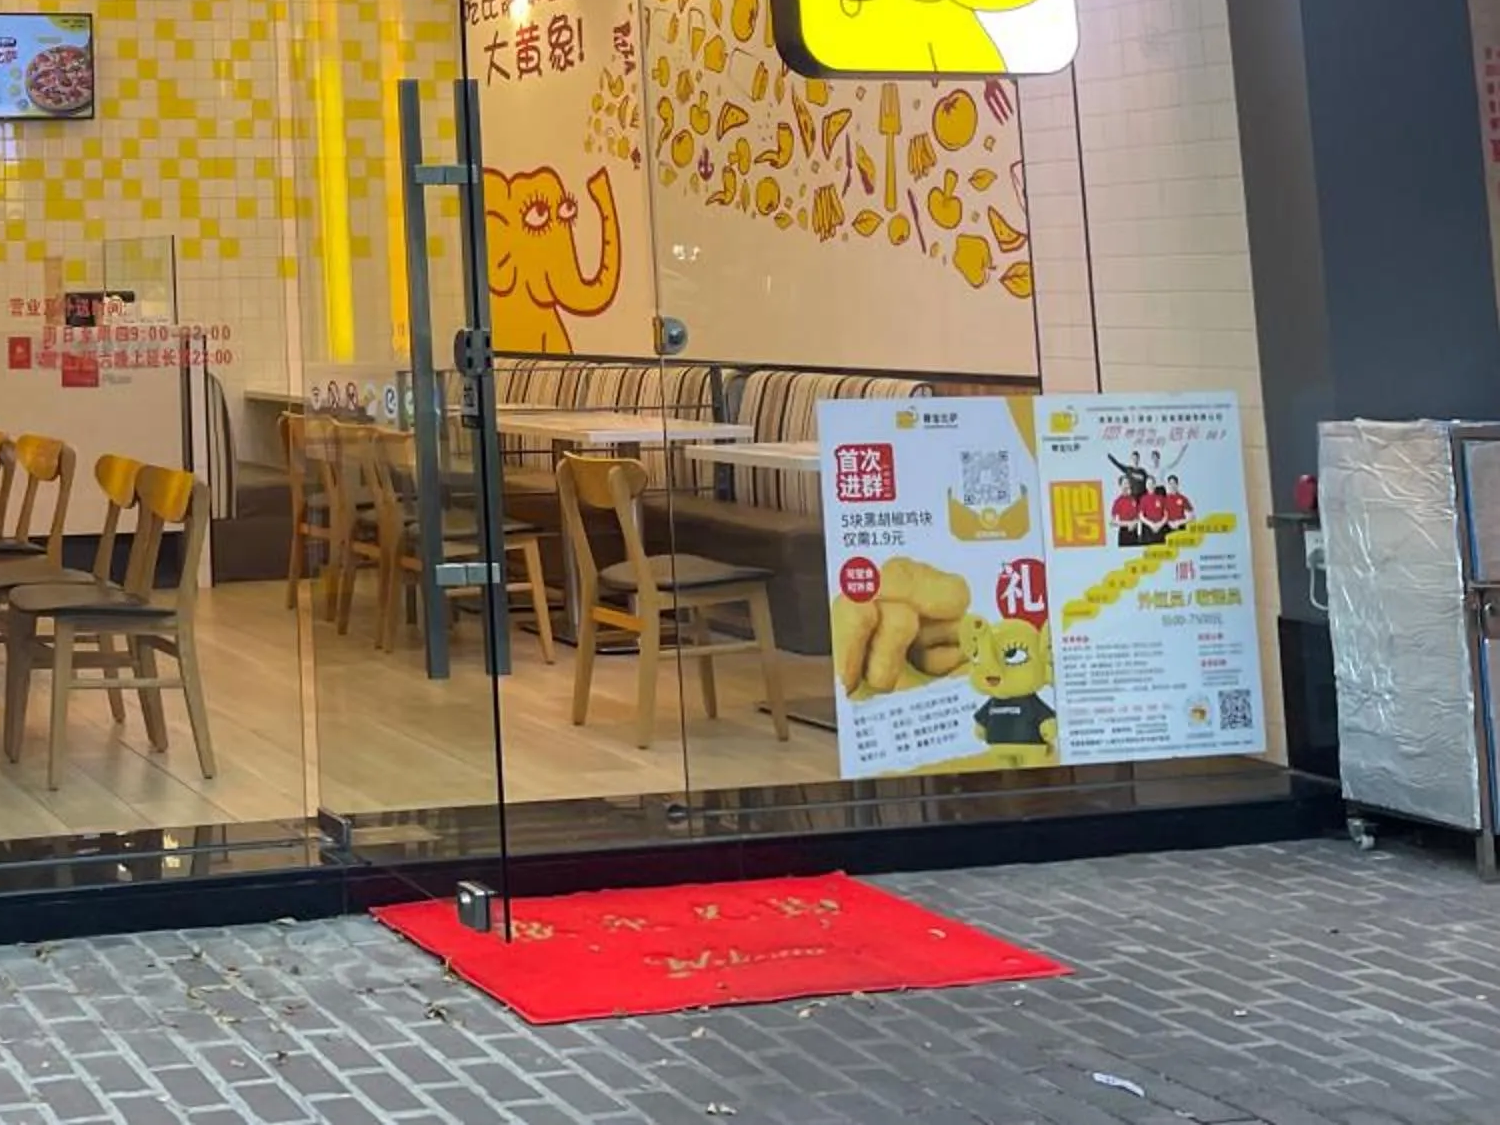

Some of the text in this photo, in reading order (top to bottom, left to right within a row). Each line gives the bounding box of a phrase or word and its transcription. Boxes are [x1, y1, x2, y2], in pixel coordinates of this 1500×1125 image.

[484, 14, 585, 87] 大黄象!
[837, 448, 881, 473] 首次
[838, 473, 883, 498] 进群
[841, 511, 933, 529] 5块黑胡椒鸡块
[843, 530, 906, 548] 仅需1.9元
[1000, 564, 1045, 615] 礼
